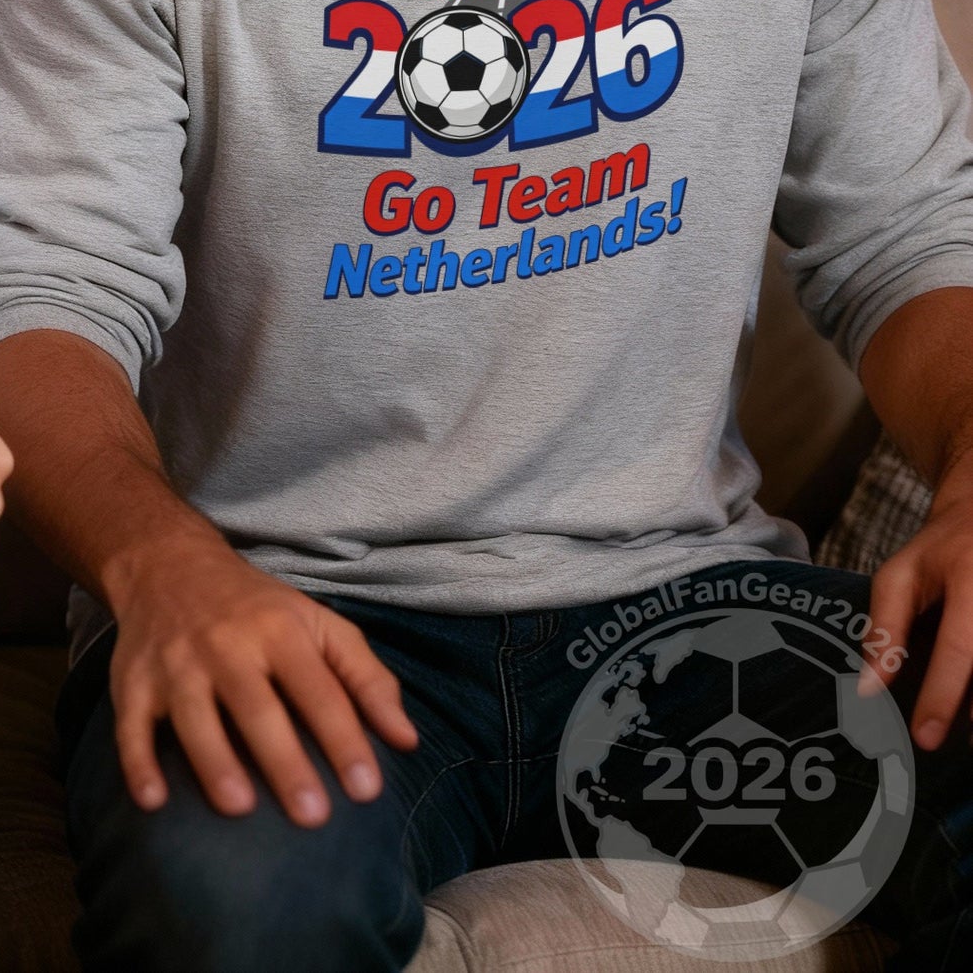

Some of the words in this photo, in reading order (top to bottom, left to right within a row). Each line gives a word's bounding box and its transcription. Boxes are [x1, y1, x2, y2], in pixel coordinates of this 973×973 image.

[324, 177, 688, 299] Netherlands!
[363, 170, 455, 236] Go
[473, 143, 650, 228] Team
